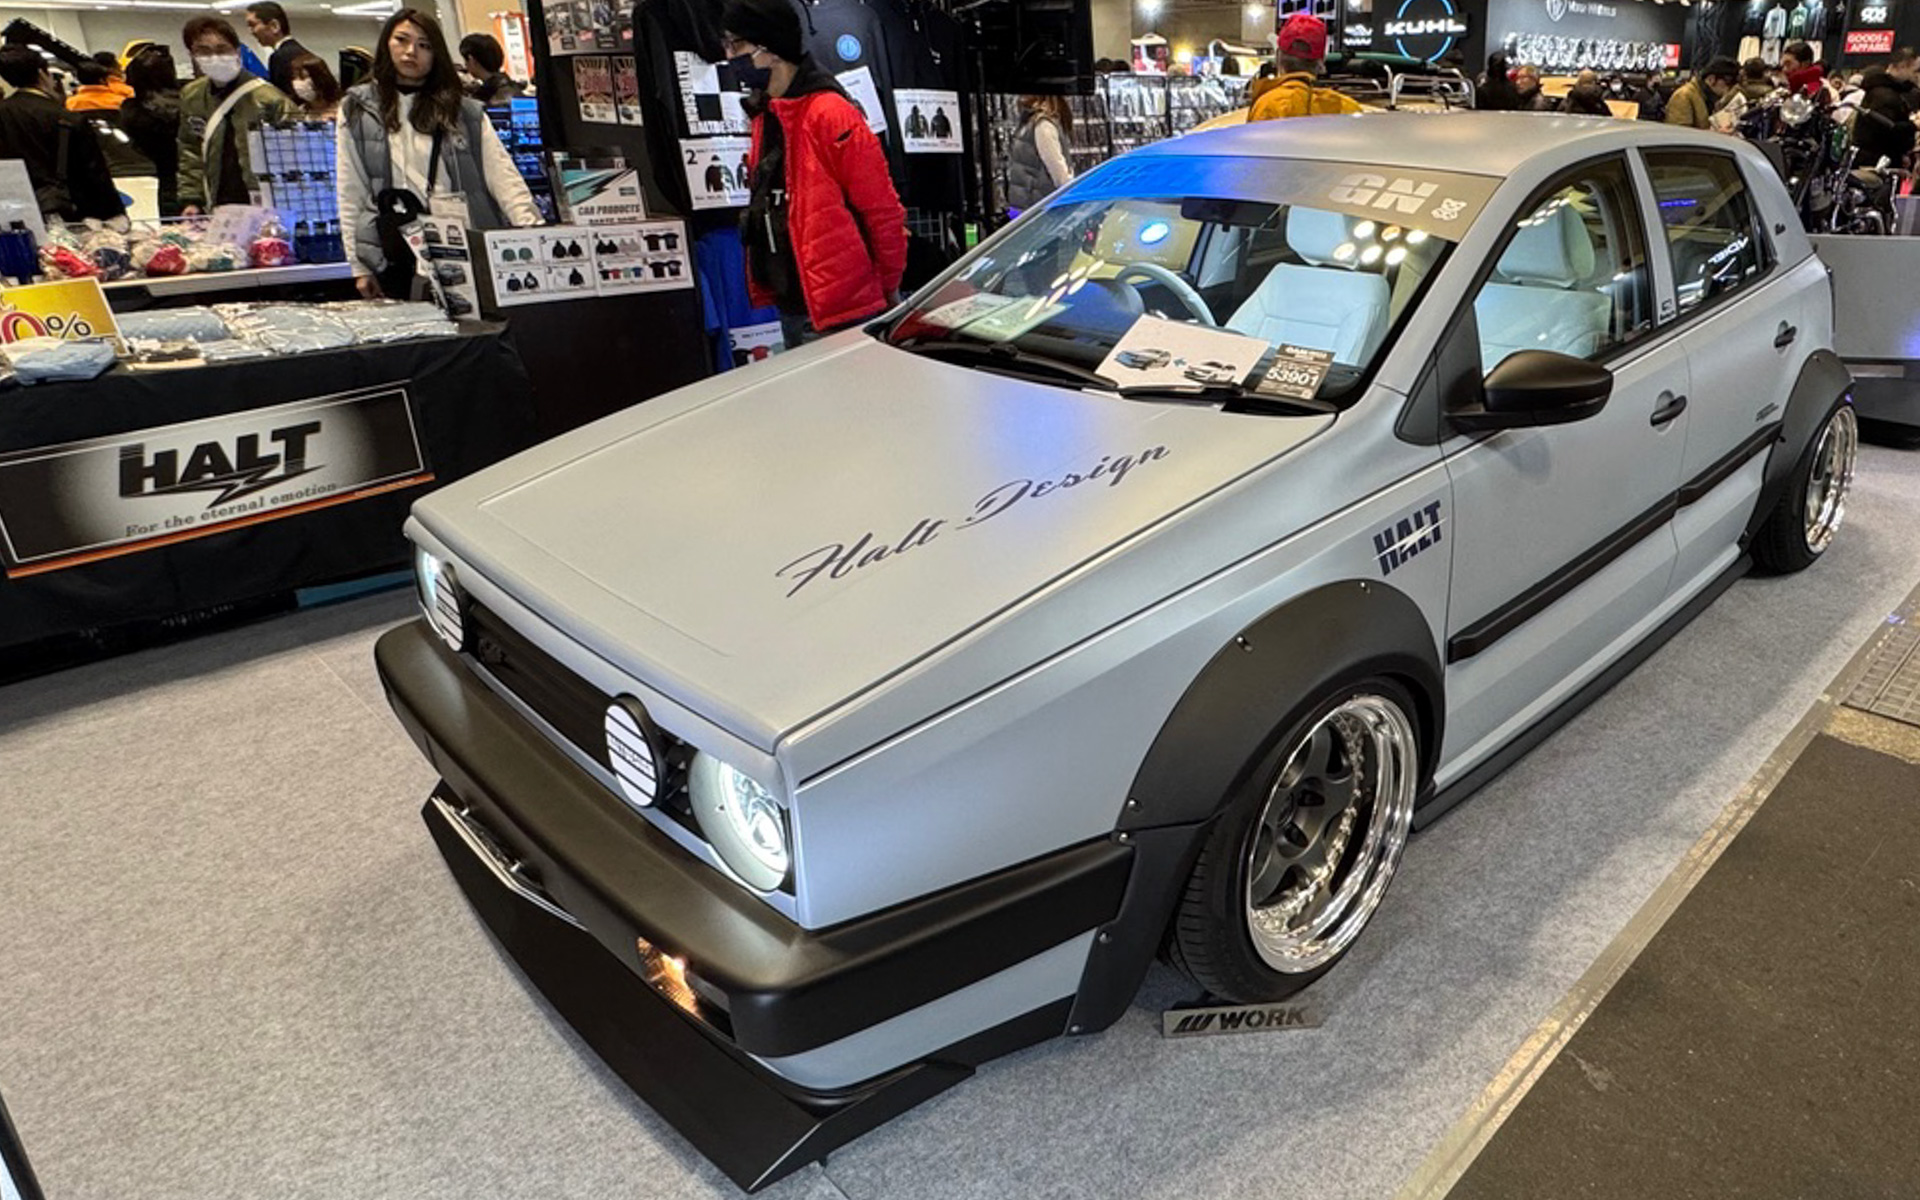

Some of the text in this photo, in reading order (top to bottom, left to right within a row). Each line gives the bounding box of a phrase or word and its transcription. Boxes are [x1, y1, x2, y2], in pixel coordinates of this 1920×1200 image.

[1384, 19, 1467, 35] KUHL
[685, 149, 698, 165] 2
[578, 203, 640, 215] CAR PRODUCTS
[1266, 367, 1320, 387] 53901
[119, 421, 323, 500] HALT
[125, 481, 338, 538] For the eternal emotion
[775, 444, 1170, 598] Halt Design
[1373, 500, 1445, 577] HALT
[1219, 1006, 1309, 1030] WORK
